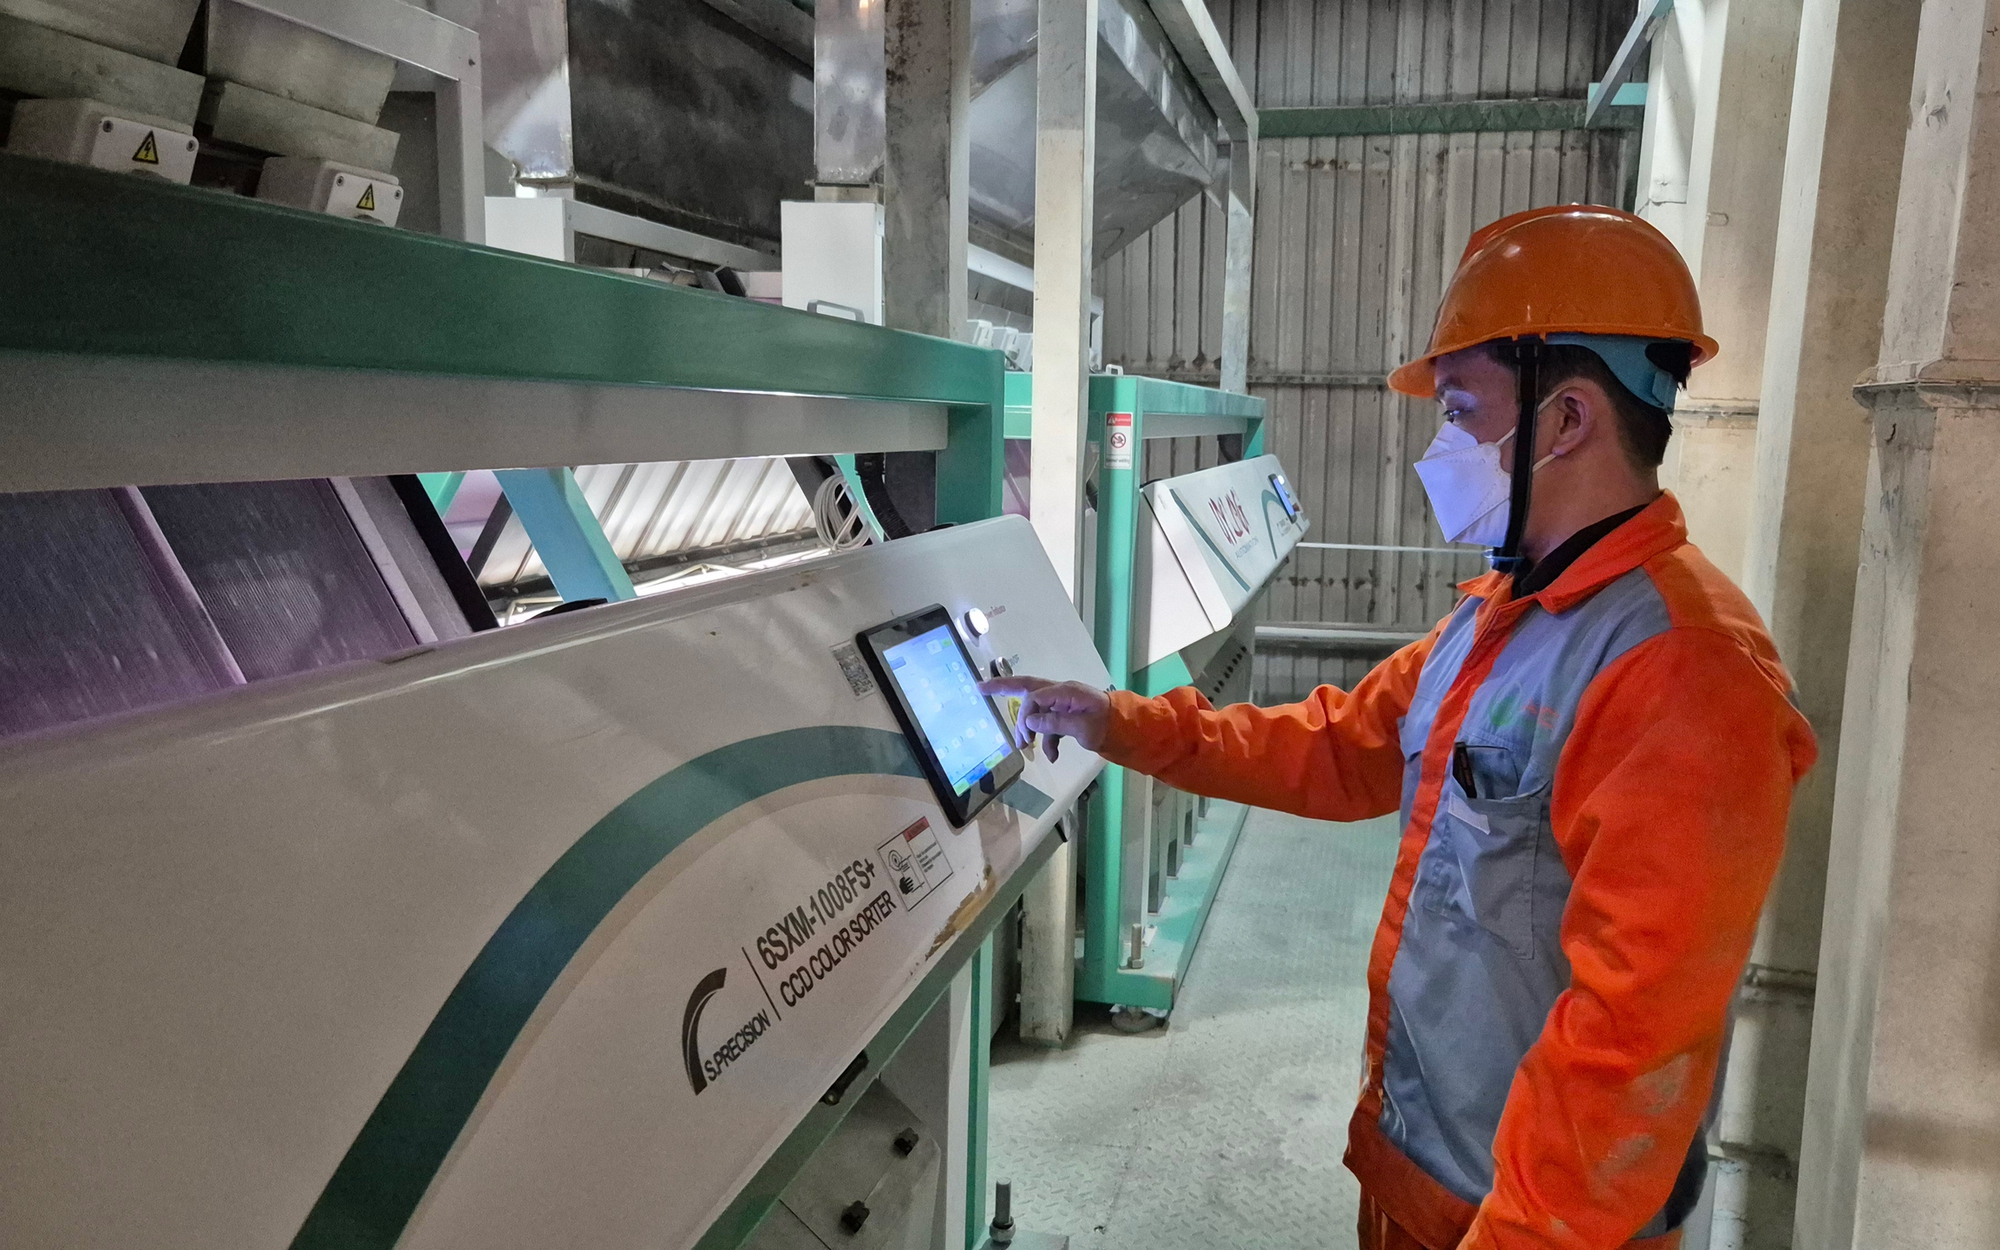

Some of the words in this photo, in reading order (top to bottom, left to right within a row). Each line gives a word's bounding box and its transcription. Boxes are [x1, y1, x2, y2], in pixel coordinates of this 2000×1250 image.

[757, 858, 875, 970] 6SXM-1008FS+
[780, 966, 814, 1007] CCD
[809, 927, 857, 980] COLOR
[849, 890, 897, 942] SORTER
